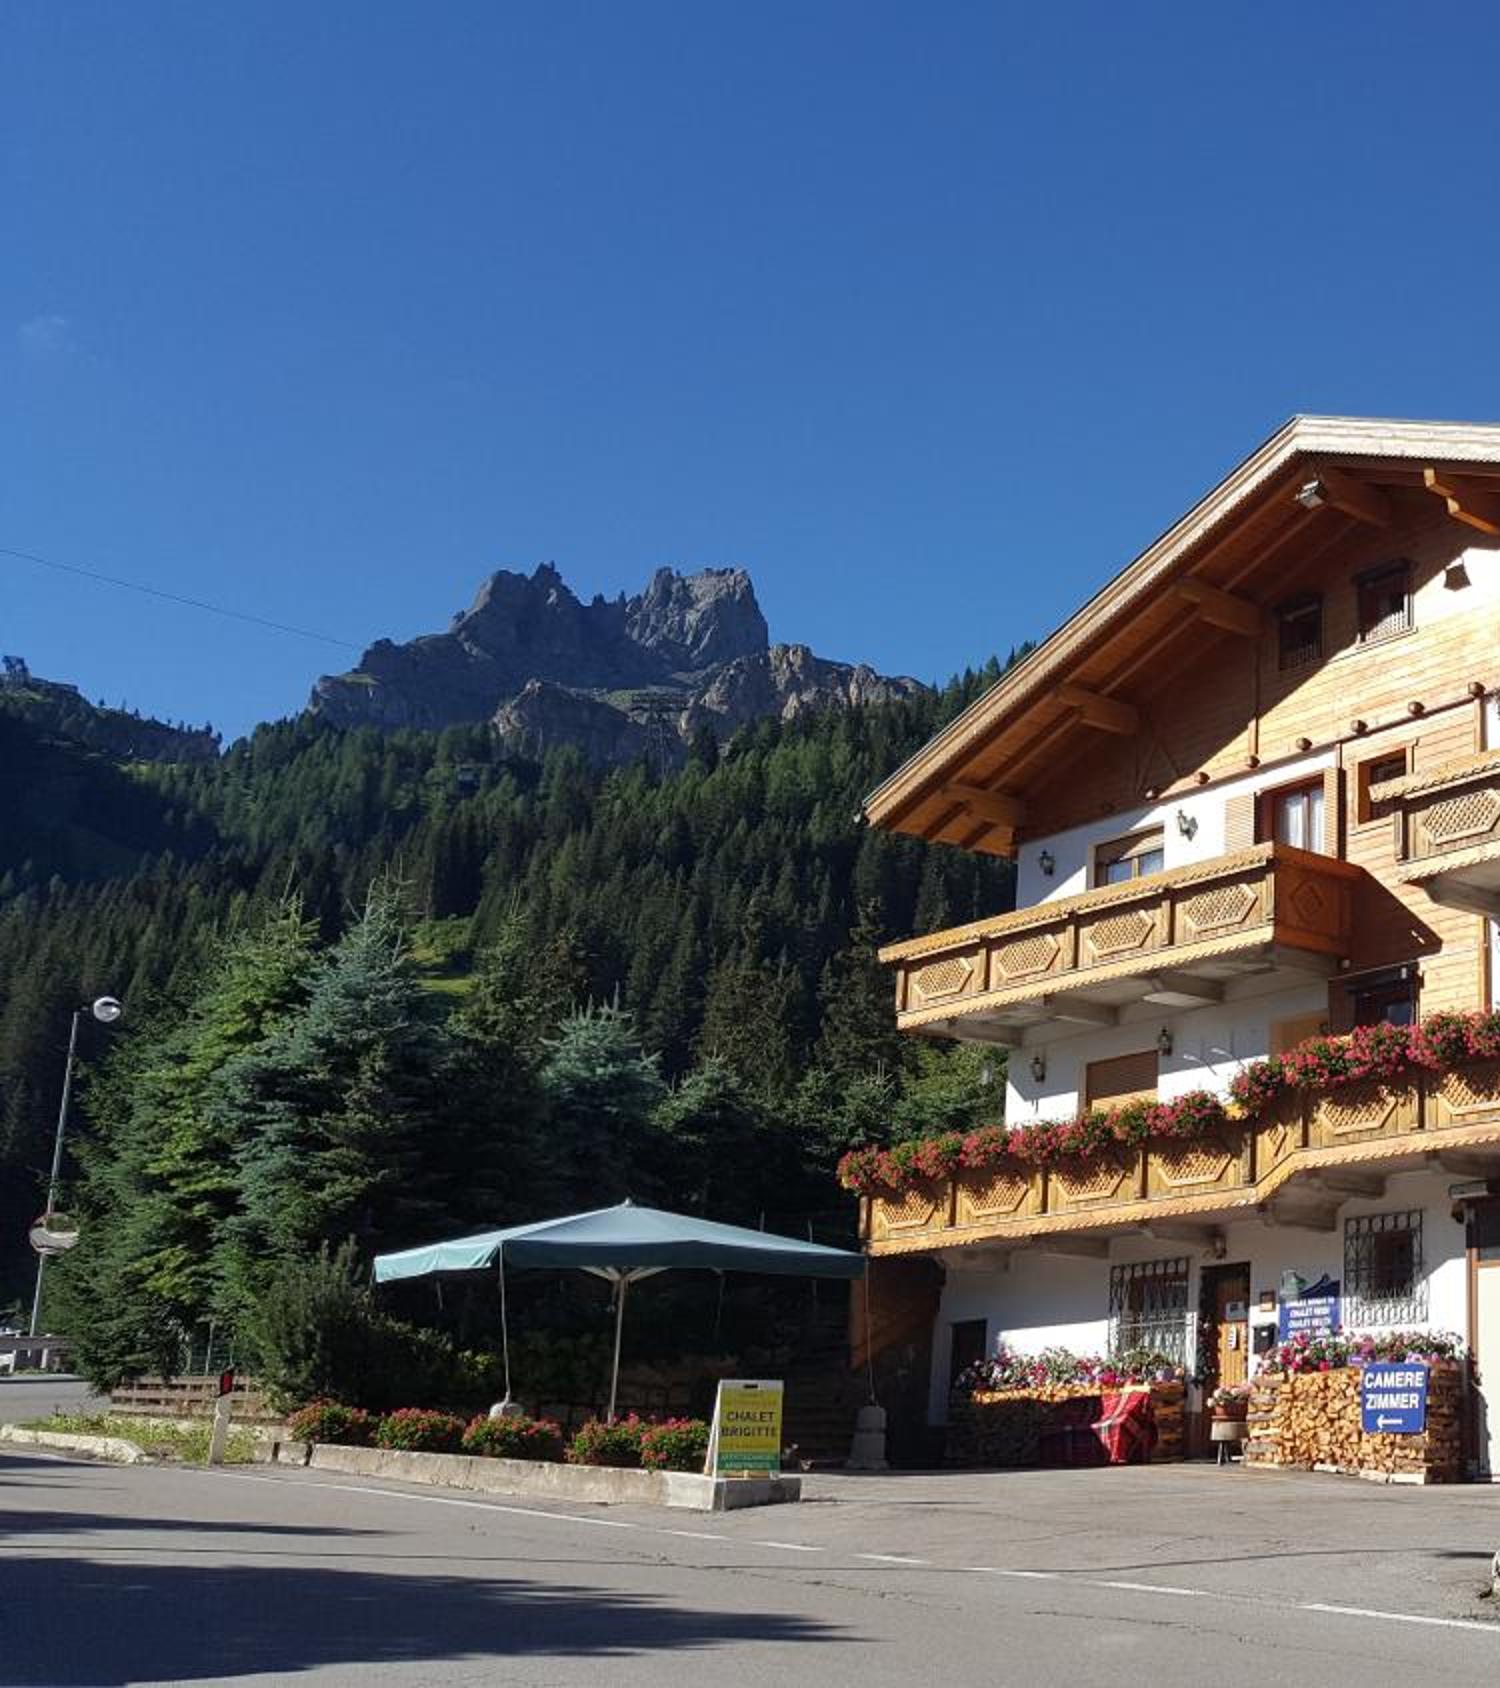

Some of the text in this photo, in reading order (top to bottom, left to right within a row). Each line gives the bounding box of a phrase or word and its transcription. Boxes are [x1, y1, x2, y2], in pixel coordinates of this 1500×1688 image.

[1365, 1371, 1425, 1388] CAMERE
[1365, 1393, 1419, 1410] ZIMMER
[727, 1411, 775, 1422] CHALET
[721, 1426, 776, 1437] BRIGITTE
